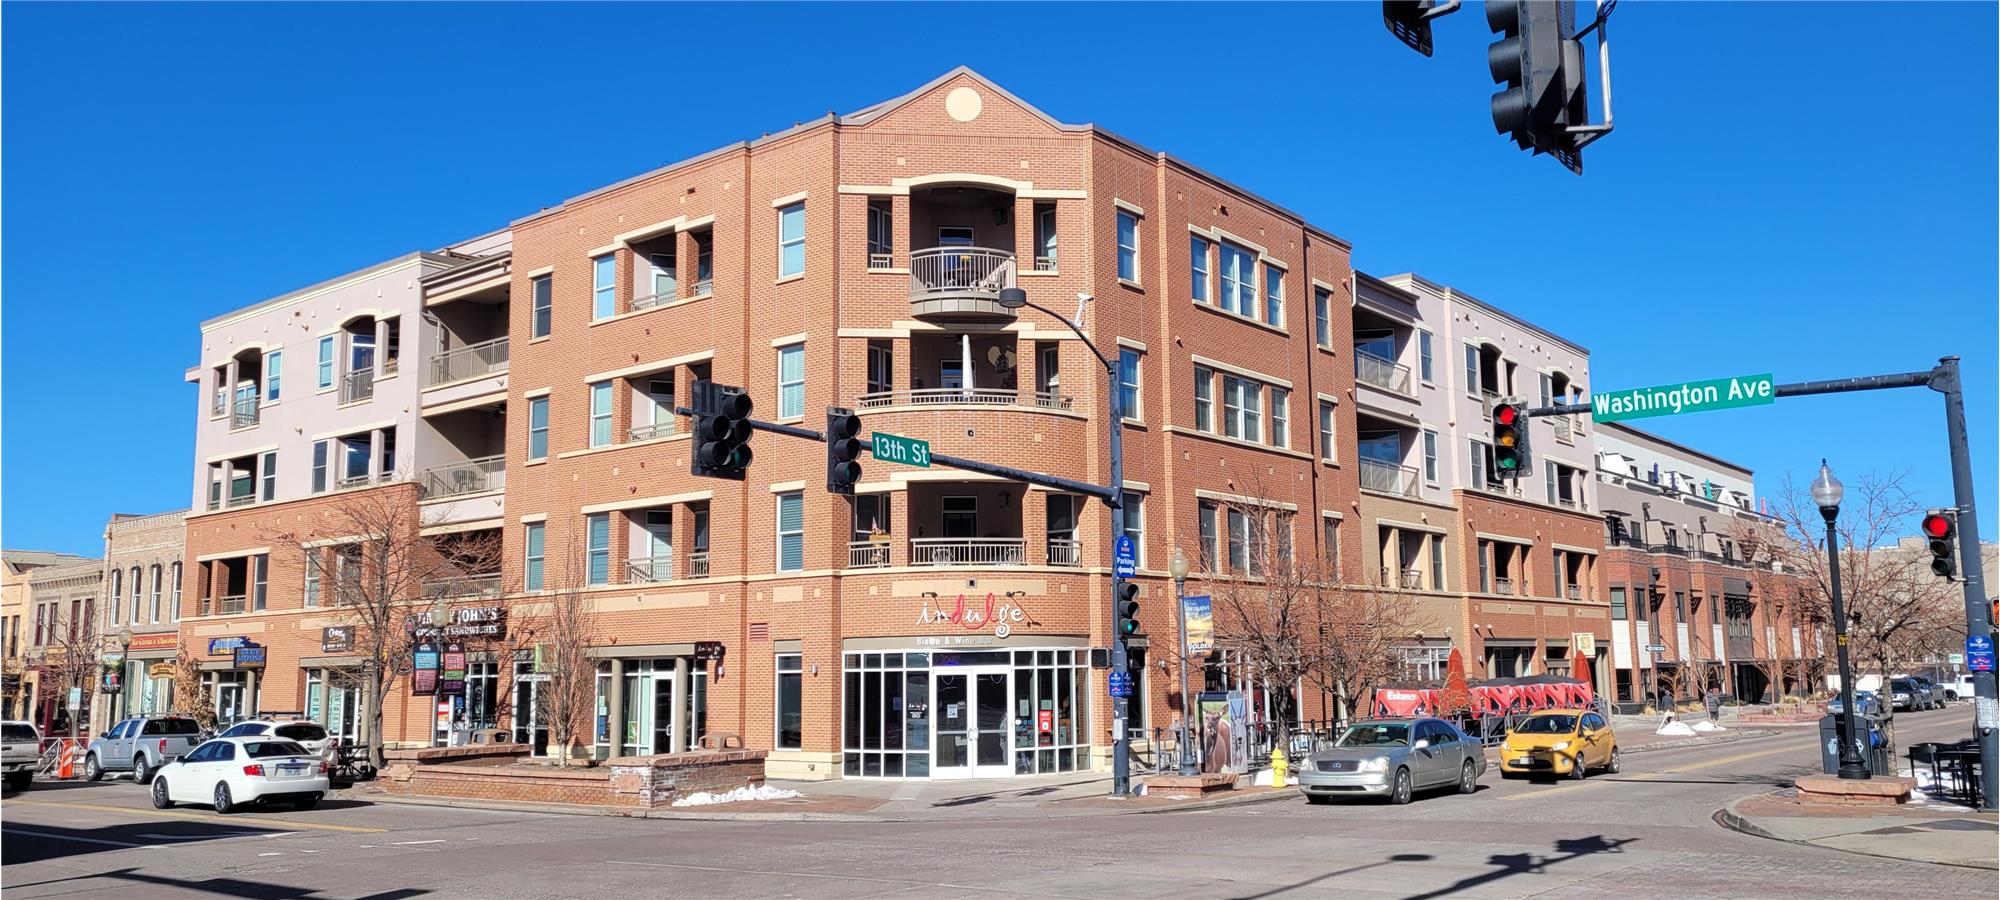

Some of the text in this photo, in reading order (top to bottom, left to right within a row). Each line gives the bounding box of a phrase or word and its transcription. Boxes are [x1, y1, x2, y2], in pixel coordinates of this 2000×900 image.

[1593, 378, 1771, 416] Washington Ave
[875, 436, 928, 464] 13th St
[1117, 557, 1135, 567] Parking
[417, 606, 498, 625] JIMY JOHN'S
[916, 592, 1025, 638] indulge
[416, 627, 449, 637] GOURMT
[916, 637, 941, 646] Bistro
[944, 637, 951, 646] &
